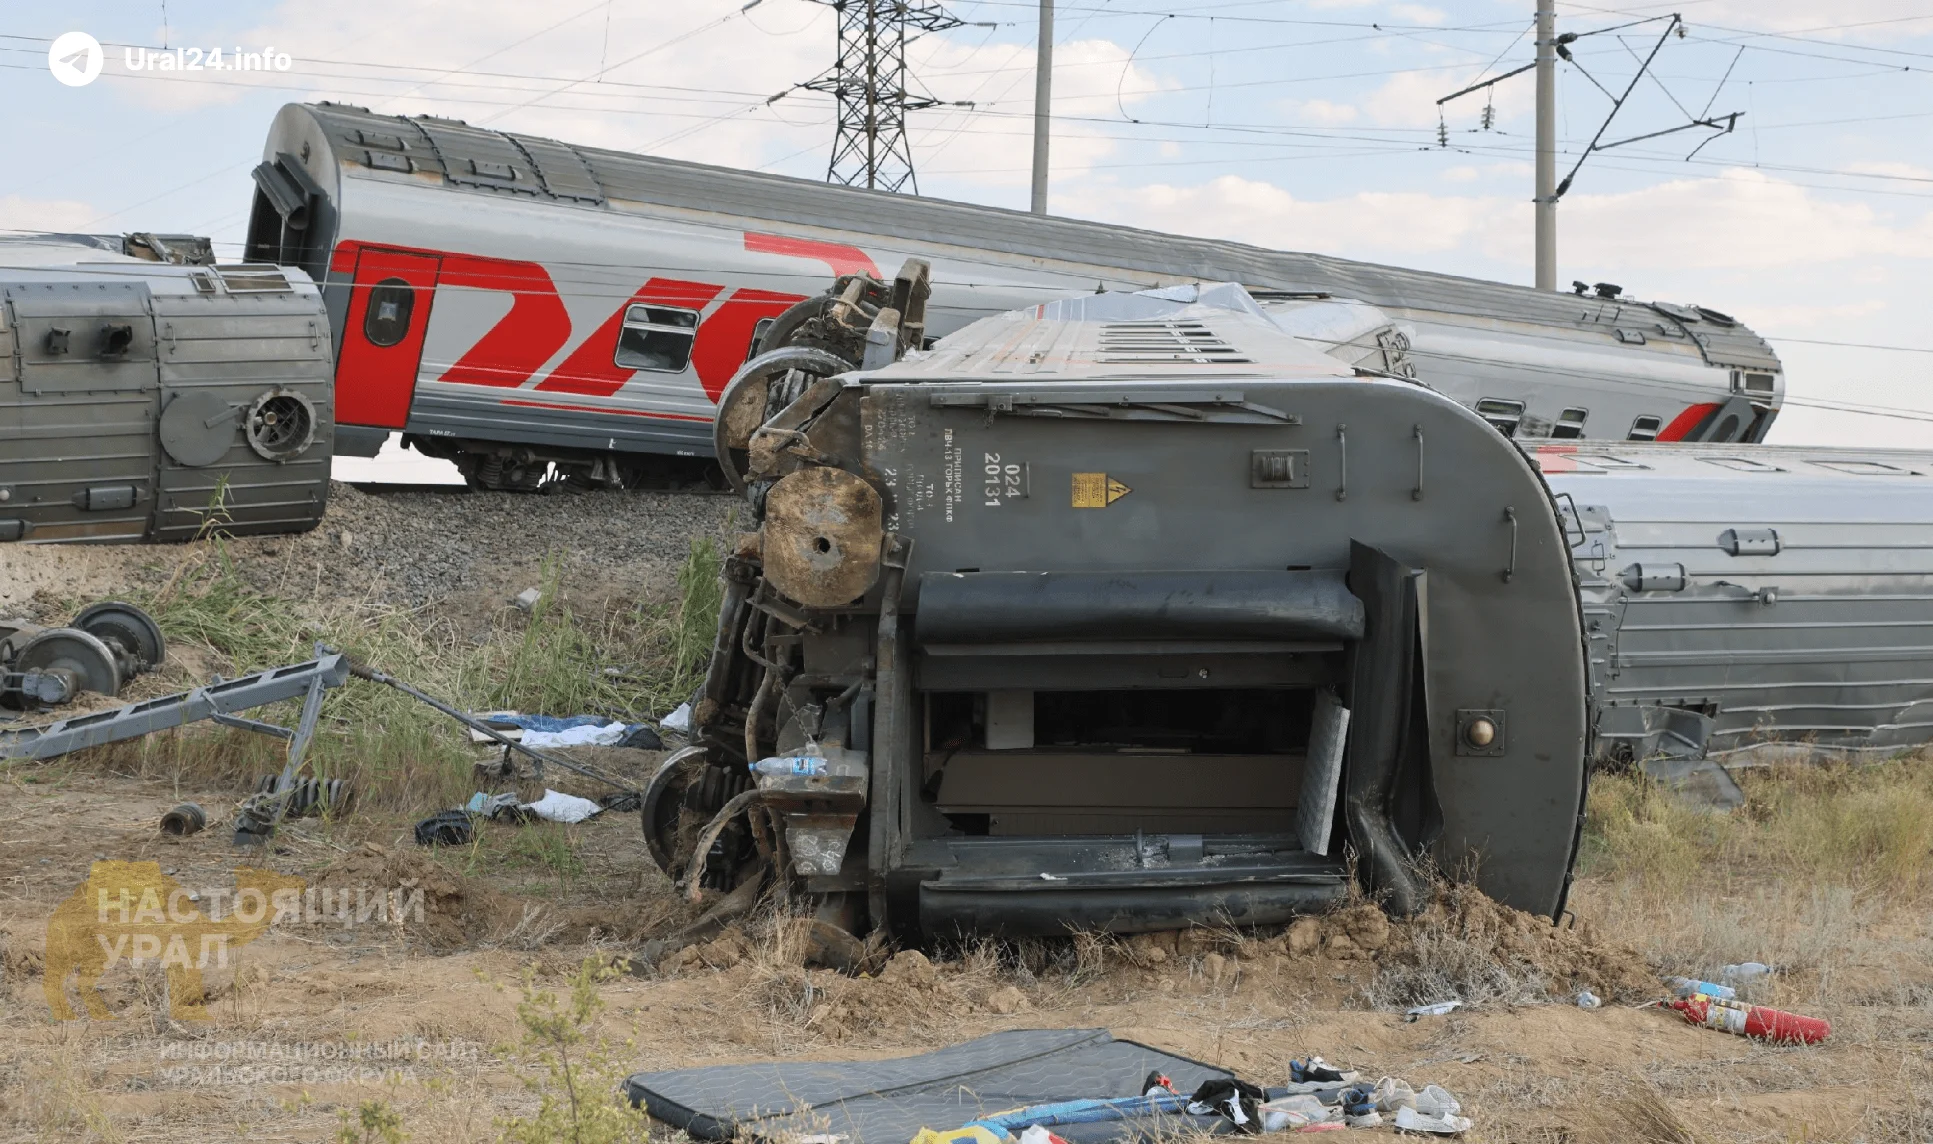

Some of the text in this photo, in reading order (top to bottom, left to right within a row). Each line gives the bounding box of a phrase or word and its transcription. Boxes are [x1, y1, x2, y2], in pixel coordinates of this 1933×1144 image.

[954, 447, 963, 503] ПРИПИСАН
[984, 452, 1001, 507] 20131
[1004, 464, 1021, 498] 024
